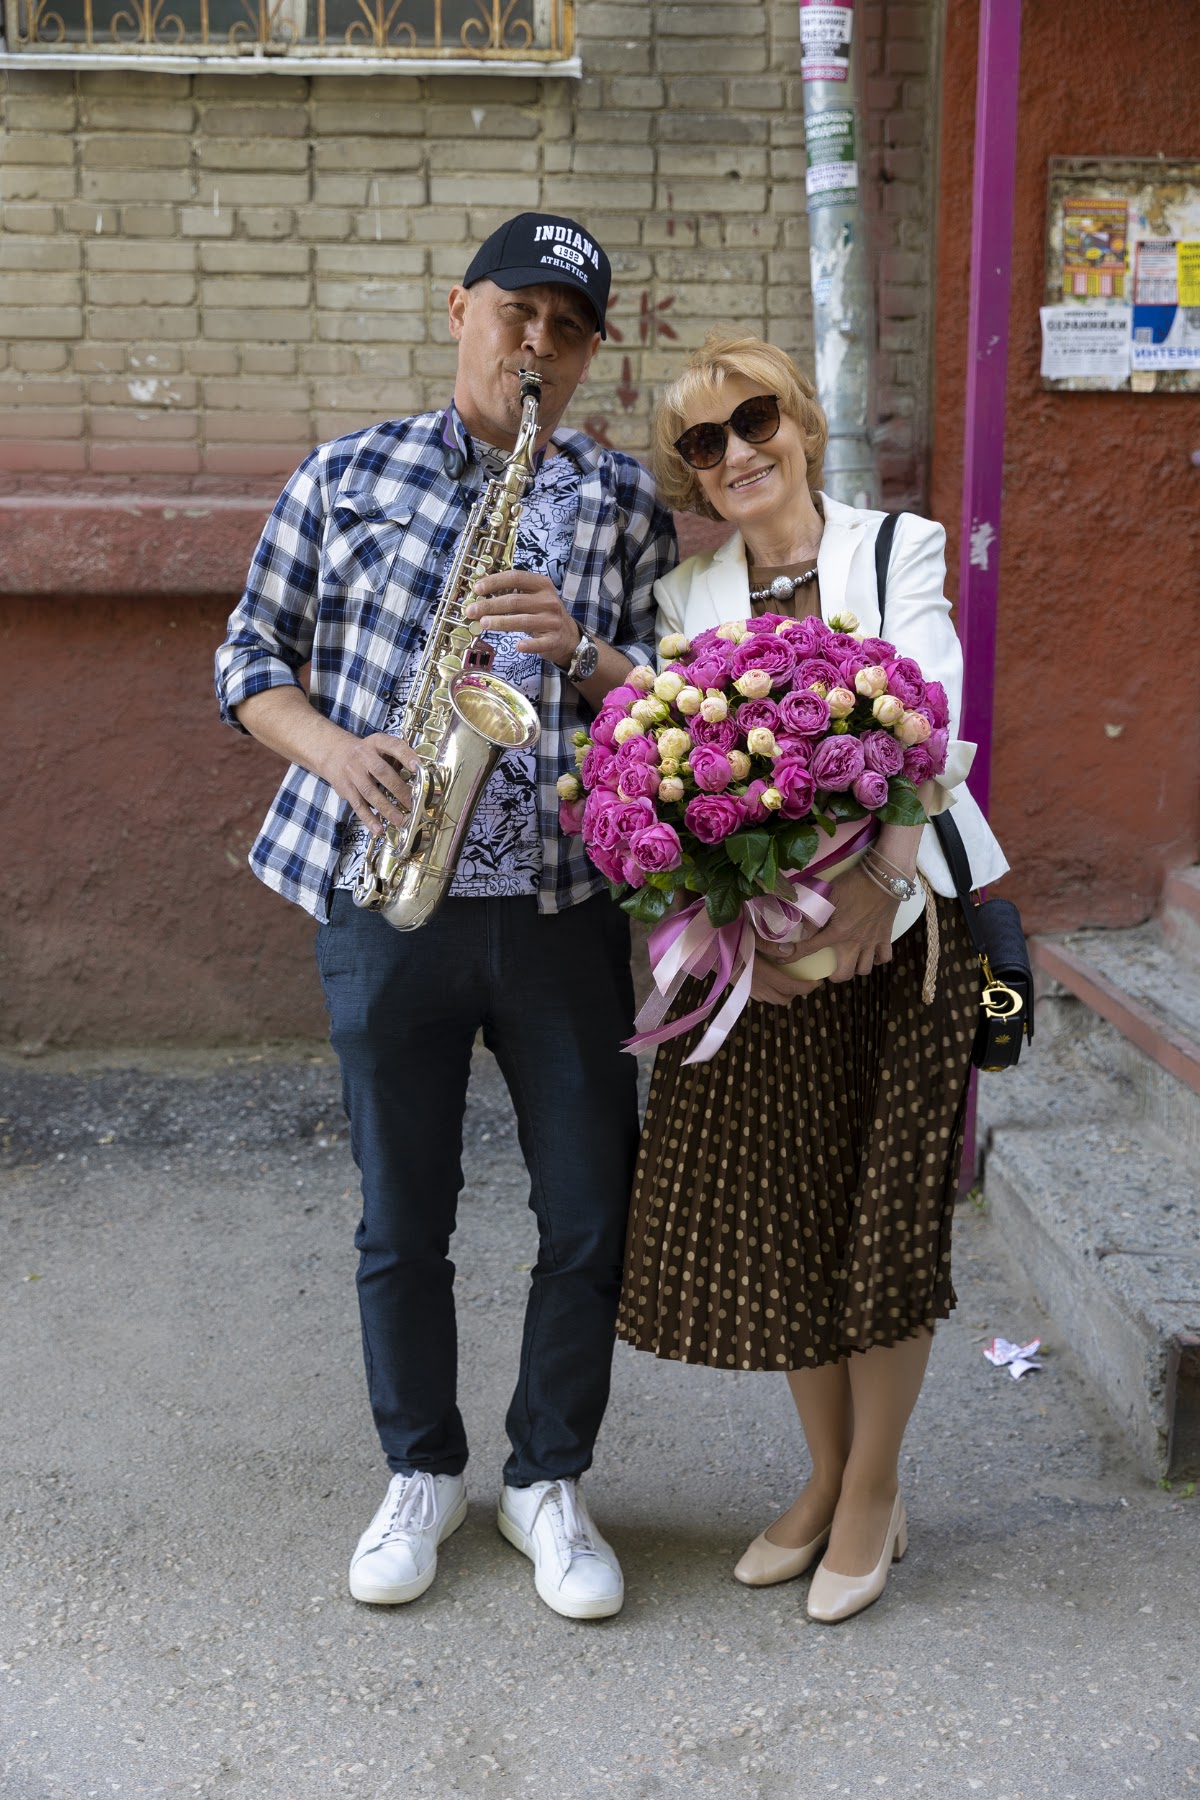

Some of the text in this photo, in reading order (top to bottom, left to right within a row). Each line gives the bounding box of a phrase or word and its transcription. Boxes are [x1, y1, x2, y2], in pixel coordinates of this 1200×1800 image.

[533, 225, 600, 270] INDIANA
[558, 246, 580, 263] 1992
[540, 255, 589, 283] ATHLETICS
[1135, 347, 1200, 358] ИНТЕРН
